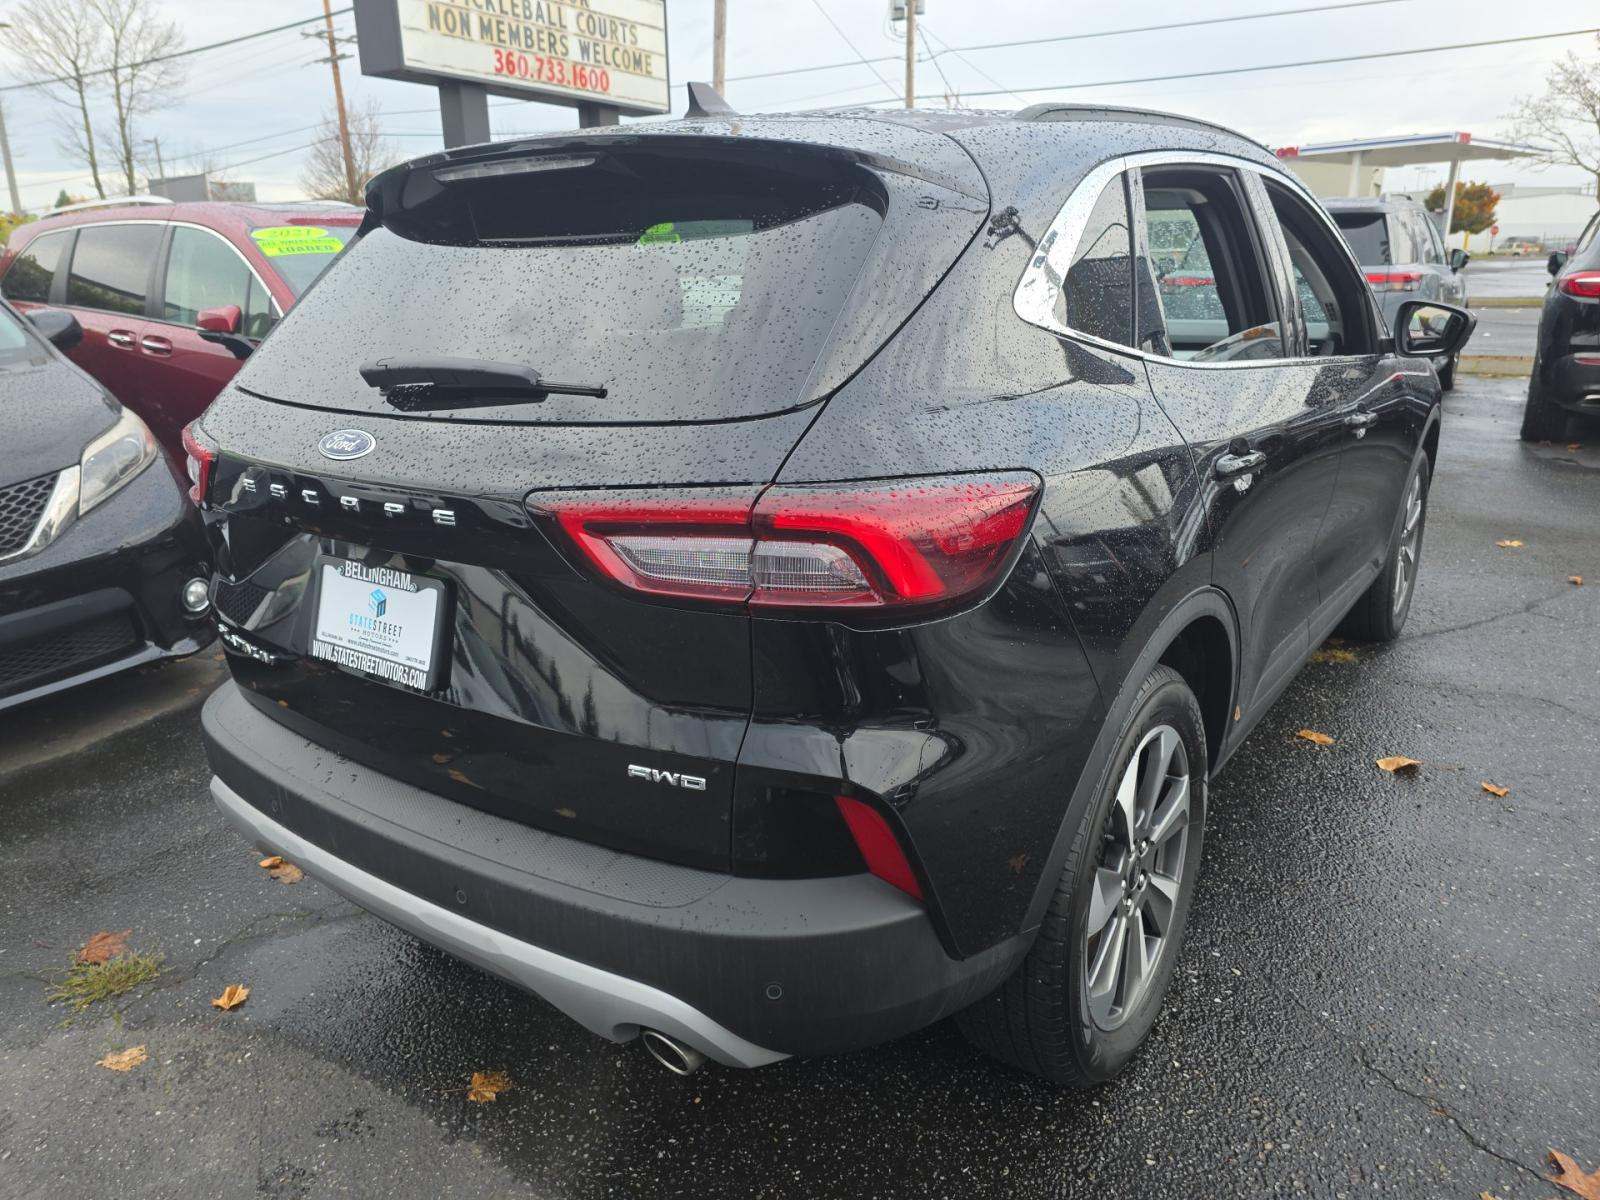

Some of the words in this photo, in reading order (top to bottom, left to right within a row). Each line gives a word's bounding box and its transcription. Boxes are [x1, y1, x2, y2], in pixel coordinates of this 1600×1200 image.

[429, 4, 471, 37] NON
[480, 15, 569, 57] MEMBERS
[578, 39, 653, 75] WELCOME
[451, 0, 567, 29] CKLEBALL
[576, 12, 638, 46] COURTS
[494, 49, 610, 92] 360.733.1600
[326, 433, 361, 451] Ford
[243, 478, 456, 527] ESCAPE
[344, 560, 411, 591] BELLINGHAM
[628, 764, 706, 791] AWD
